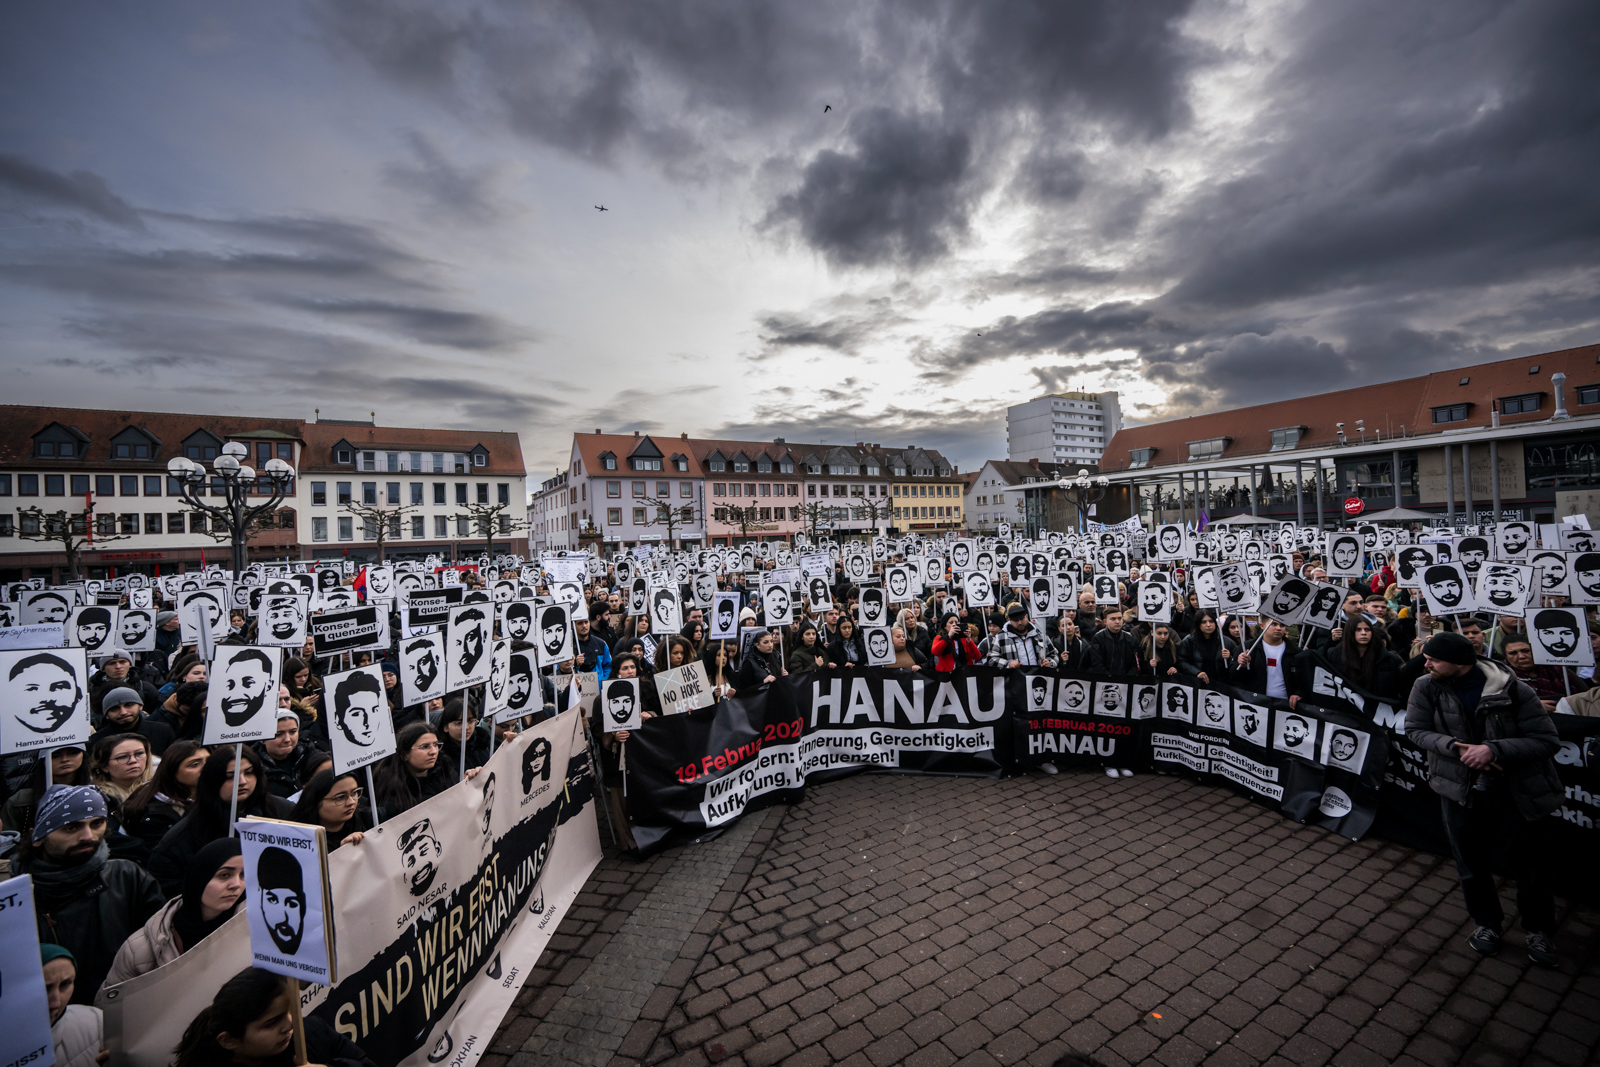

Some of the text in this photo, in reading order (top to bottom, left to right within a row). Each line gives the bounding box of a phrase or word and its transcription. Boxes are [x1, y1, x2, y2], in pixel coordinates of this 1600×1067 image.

[327, 623, 377, 640] quenzen!
[681, 664, 698, 683] HAS
[663, 690, 677, 705] NO
[680, 680, 703, 699] HOME
[810, 676, 1006, 728] HANAU
[1312, 666, 1365, 713] Ein
[674, 695, 701, 713] HERE
[1029, 718, 1131, 736] 19. FEBRUAR 2020
[1188, 731, 1230, 745] WIR FORDERN
[15, 734, 76, 748] Hamza Kurtović
[1028, 732, 1116, 757] HANAU
[1152, 735, 1202, 755] Erinnerung!
[709, 777, 736, 799] Wir
[870, 730, 990, 751] Gerechtigkeit,
[1155, 750, 1206, 771] Aufklärung!
[1210, 747, 1274, 778] Gerechtigkeit!
[1213, 763, 1282, 798] Konsequenzen!
[519, 782, 551, 808] MERCEDES
[242, 831, 315, 852] TOT SIND WIR ERST,
[396, 882, 447, 930] SAID NESAR
[537, 904, 556, 930] KALOYAN
[254, 952, 326, 976] WENN MAN UNS VERGISST
[334, 954, 414, 1046] SIND
[416, 903, 464, 977] WIR
[421, 923, 482, 1022] WENN
[502, 966, 520, 989] SEDAT
